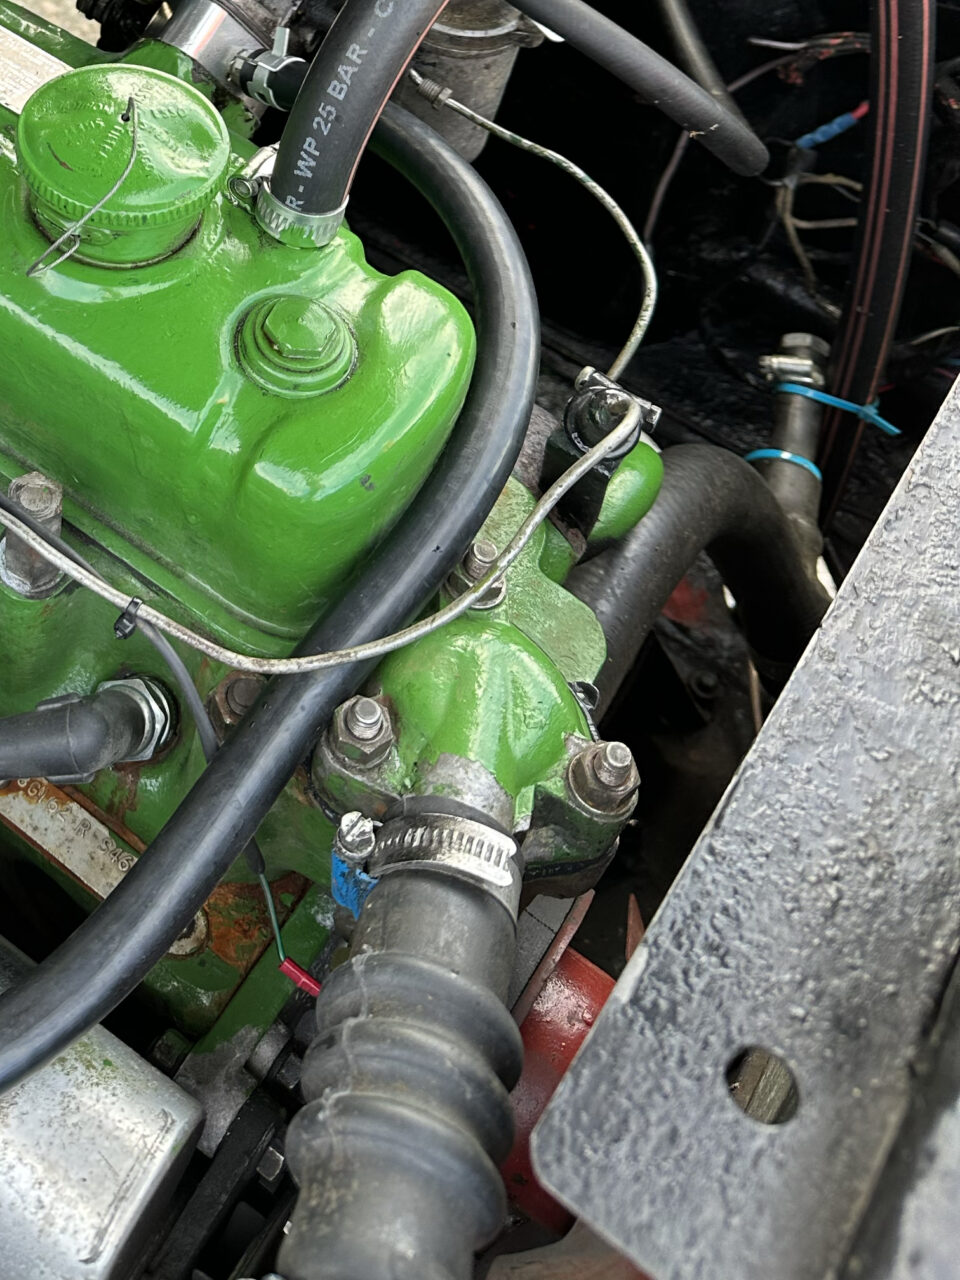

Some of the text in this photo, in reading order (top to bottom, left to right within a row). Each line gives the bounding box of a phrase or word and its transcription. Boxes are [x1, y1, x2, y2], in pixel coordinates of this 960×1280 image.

[294, 137, 318, 180] WP
[312, 104, 336, 134] 25
[331, 42, 368, 102] BAR
